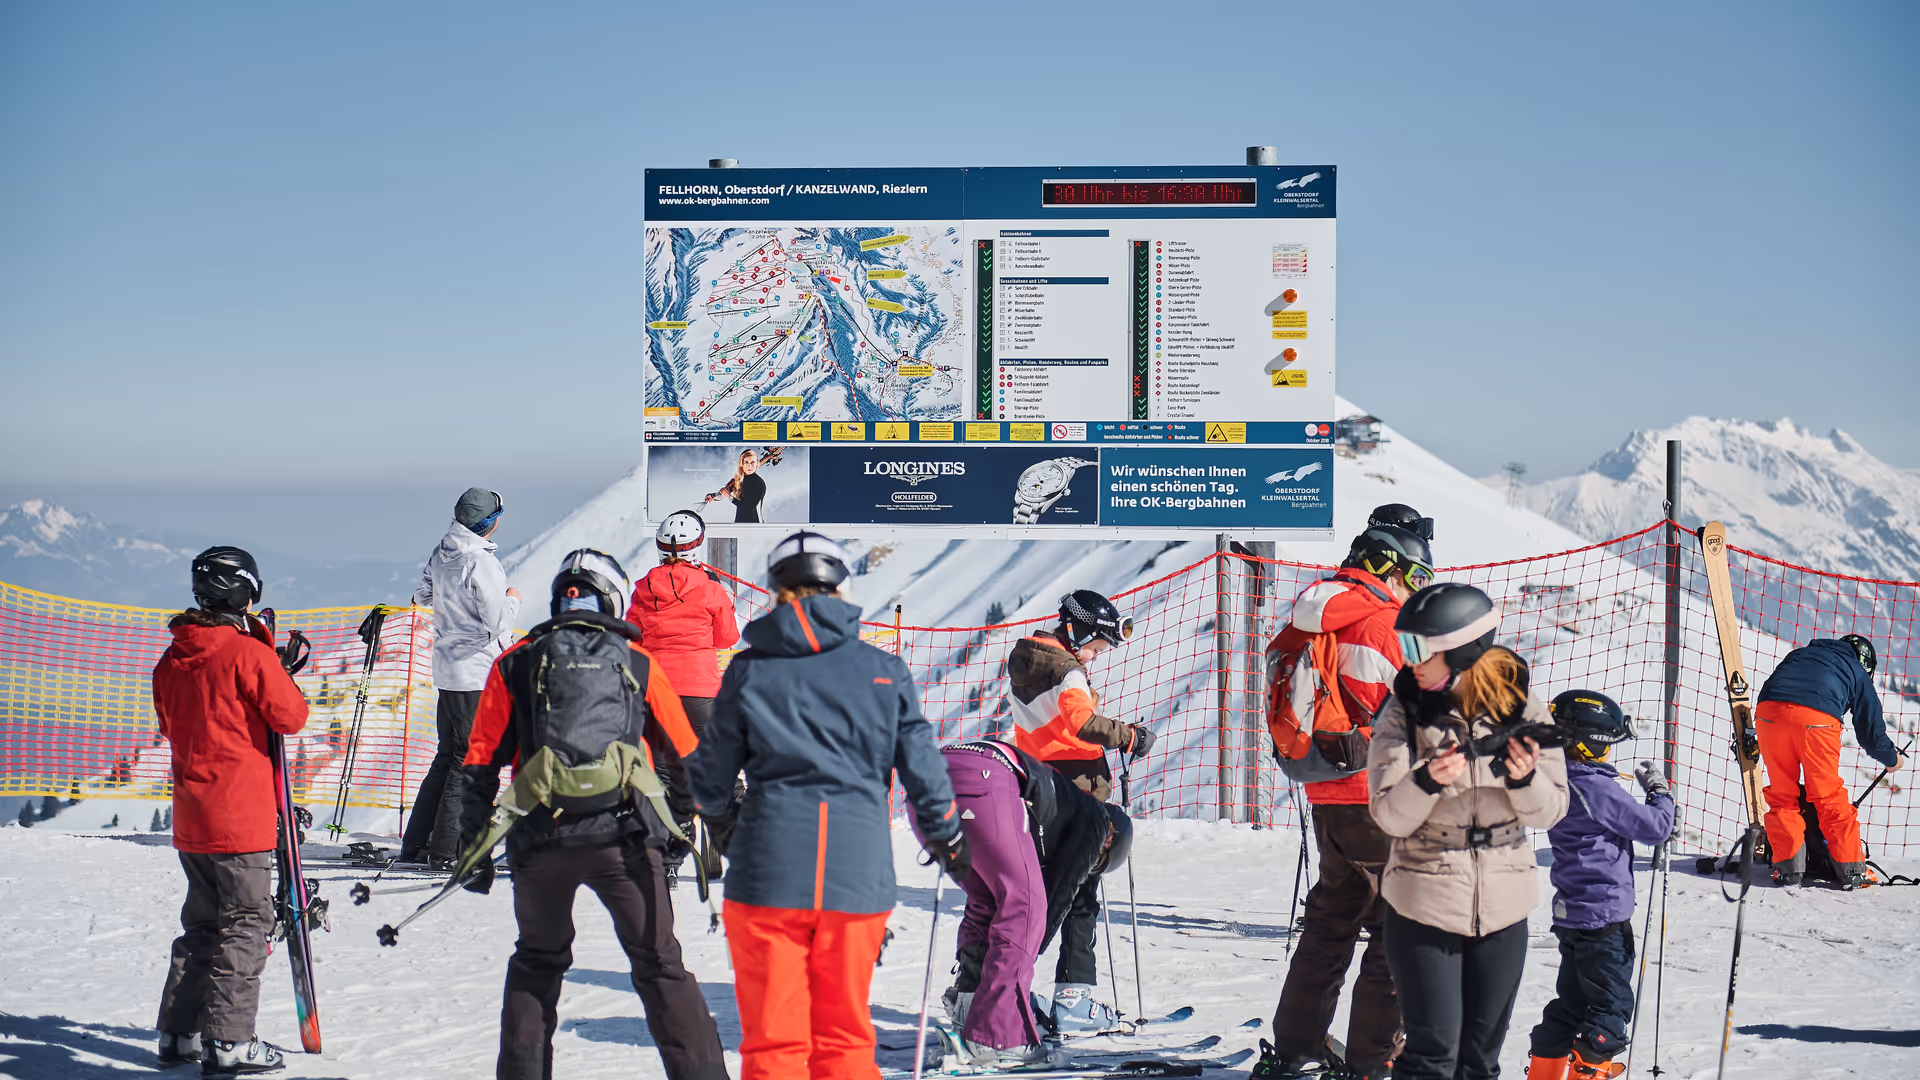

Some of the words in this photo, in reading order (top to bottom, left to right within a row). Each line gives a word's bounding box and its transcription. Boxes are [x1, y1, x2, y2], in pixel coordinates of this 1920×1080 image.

[659, 185, 722, 195] FELLHORN,
[724, 184, 786, 196] Oberstdorf
[786, 184, 794, 196] /
[795, 184, 880, 195] KANZELWAND,
[882, 183, 928, 194] Riezlern
[1083, 185, 1114, 201] Uhr
[1122, 185, 1149, 201] bis
[1157, 185, 1205, 201] 16:30
[1213, 185, 1243, 201] Uhr
[658, 197, 770, 206] www.ok-bergbahnen.com
[863, 461, 966, 475] LONGINES
[1110, 465, 1135, 477] Wir
[1137, 464, 1206, 477] wünschen
[1208, 465, 1247, 477] Ihnen
[1110, 480, 1148, 492] einen
[1150, 480, 1207, 493] schönen
[1208, 481, 1239, 495] Tag.
[1110, 496, 1138, 508] Ihre
[1140, 496, 1247, 511] OK-Bergbahnen
